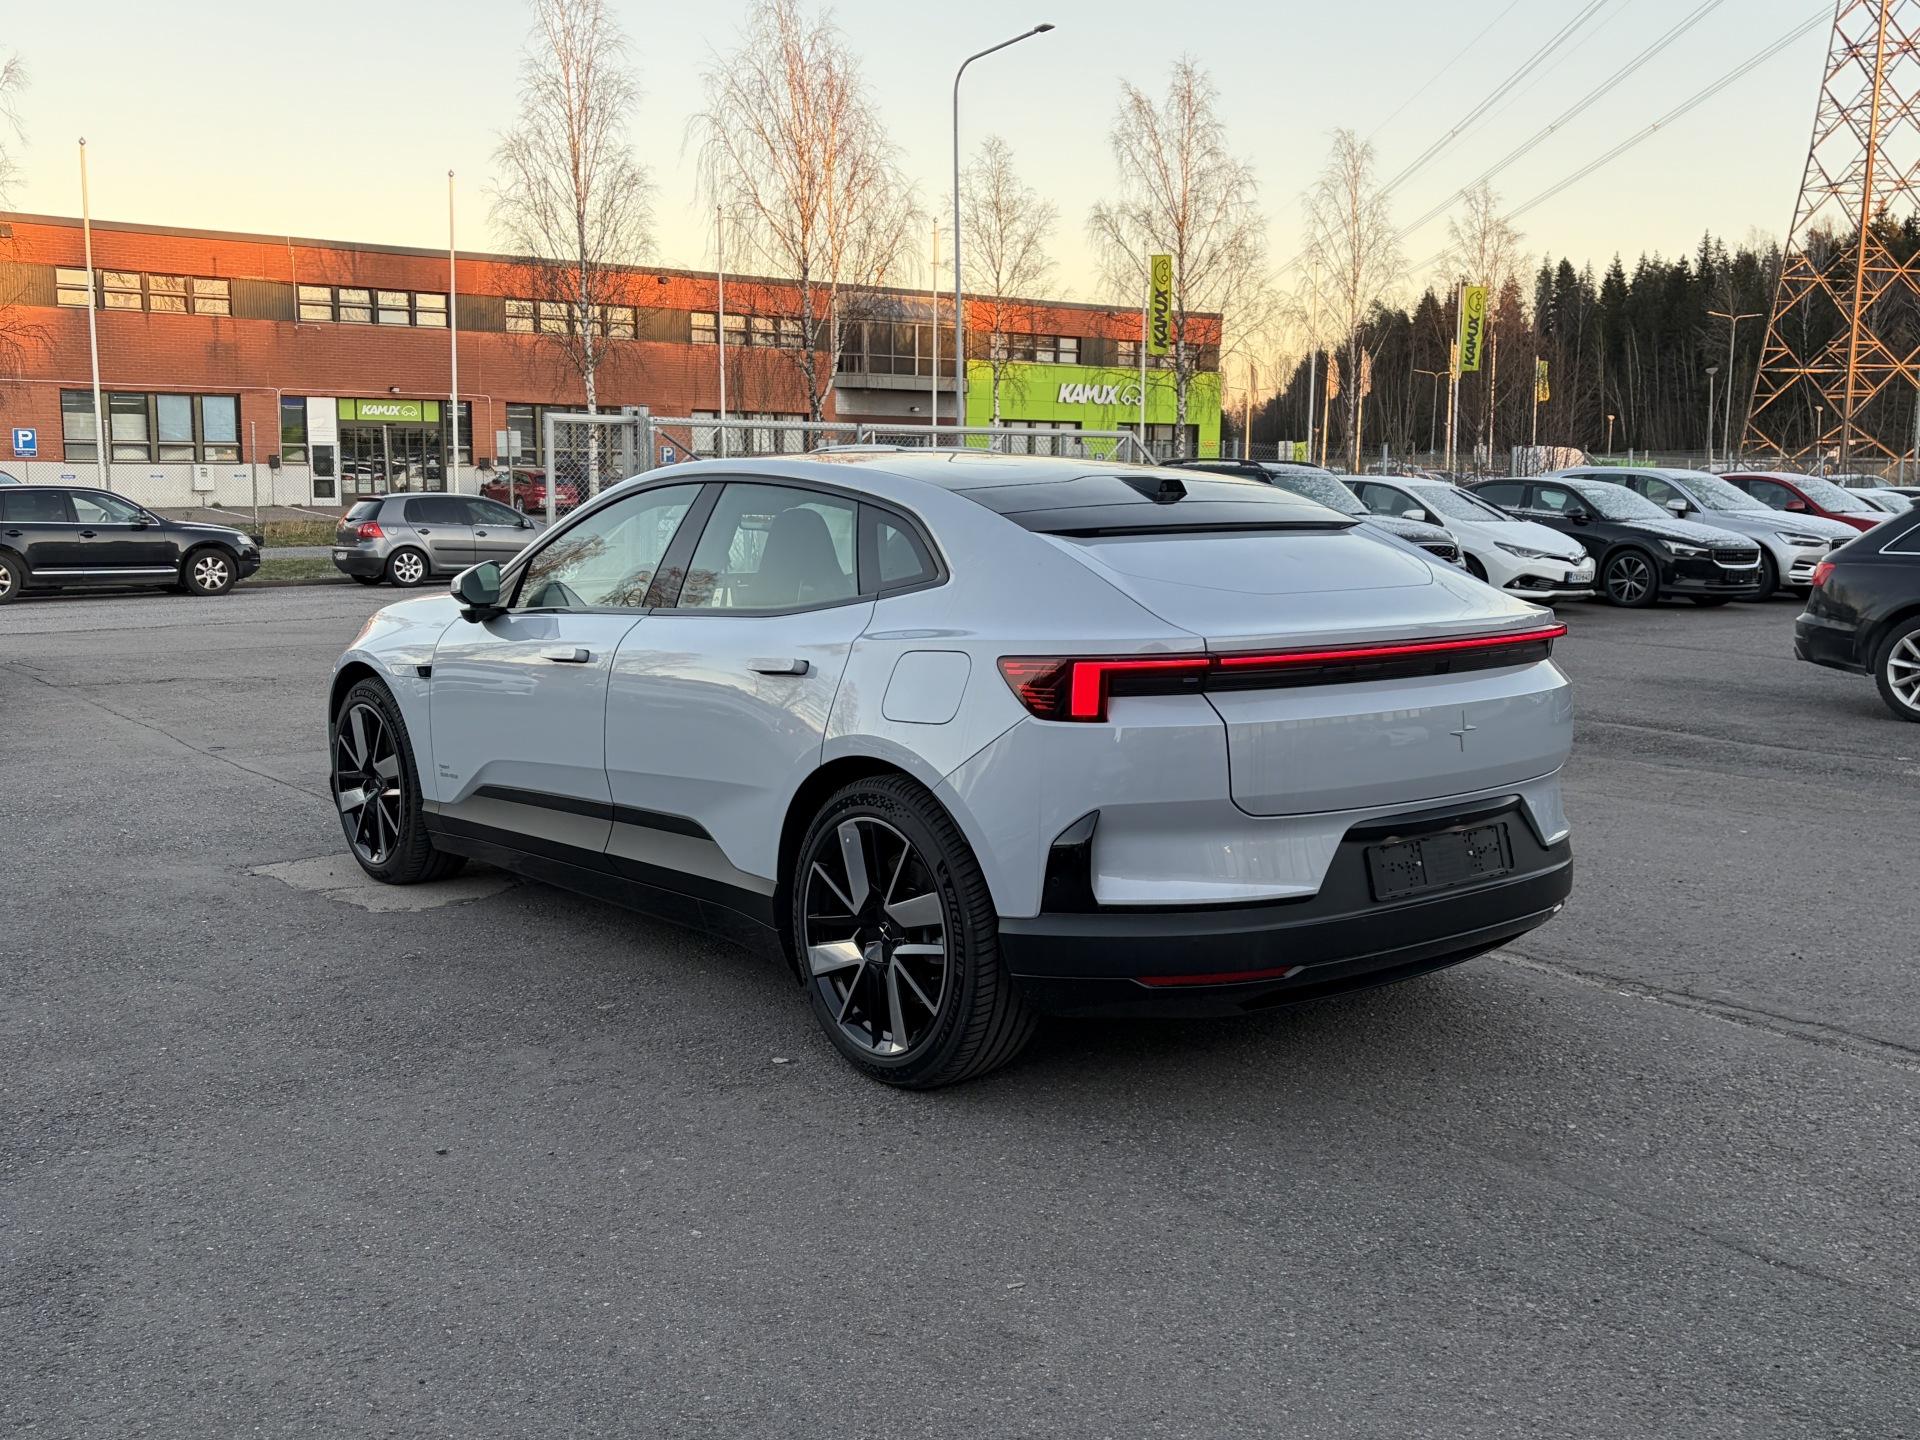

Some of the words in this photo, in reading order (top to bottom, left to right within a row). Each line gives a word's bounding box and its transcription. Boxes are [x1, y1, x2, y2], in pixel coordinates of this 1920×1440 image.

[1154, 286, 1168, 348] KAMUX
[1464, 313, 1480, 366] KAMUX
[1058, 383, 1120, 404] KAMUX
[361, 404, 401, 416] KAMUX
[18, 430, 33, 448] P
[663, 447, 673, 462] P
[945, 886, 965, 978] MICHELIN
